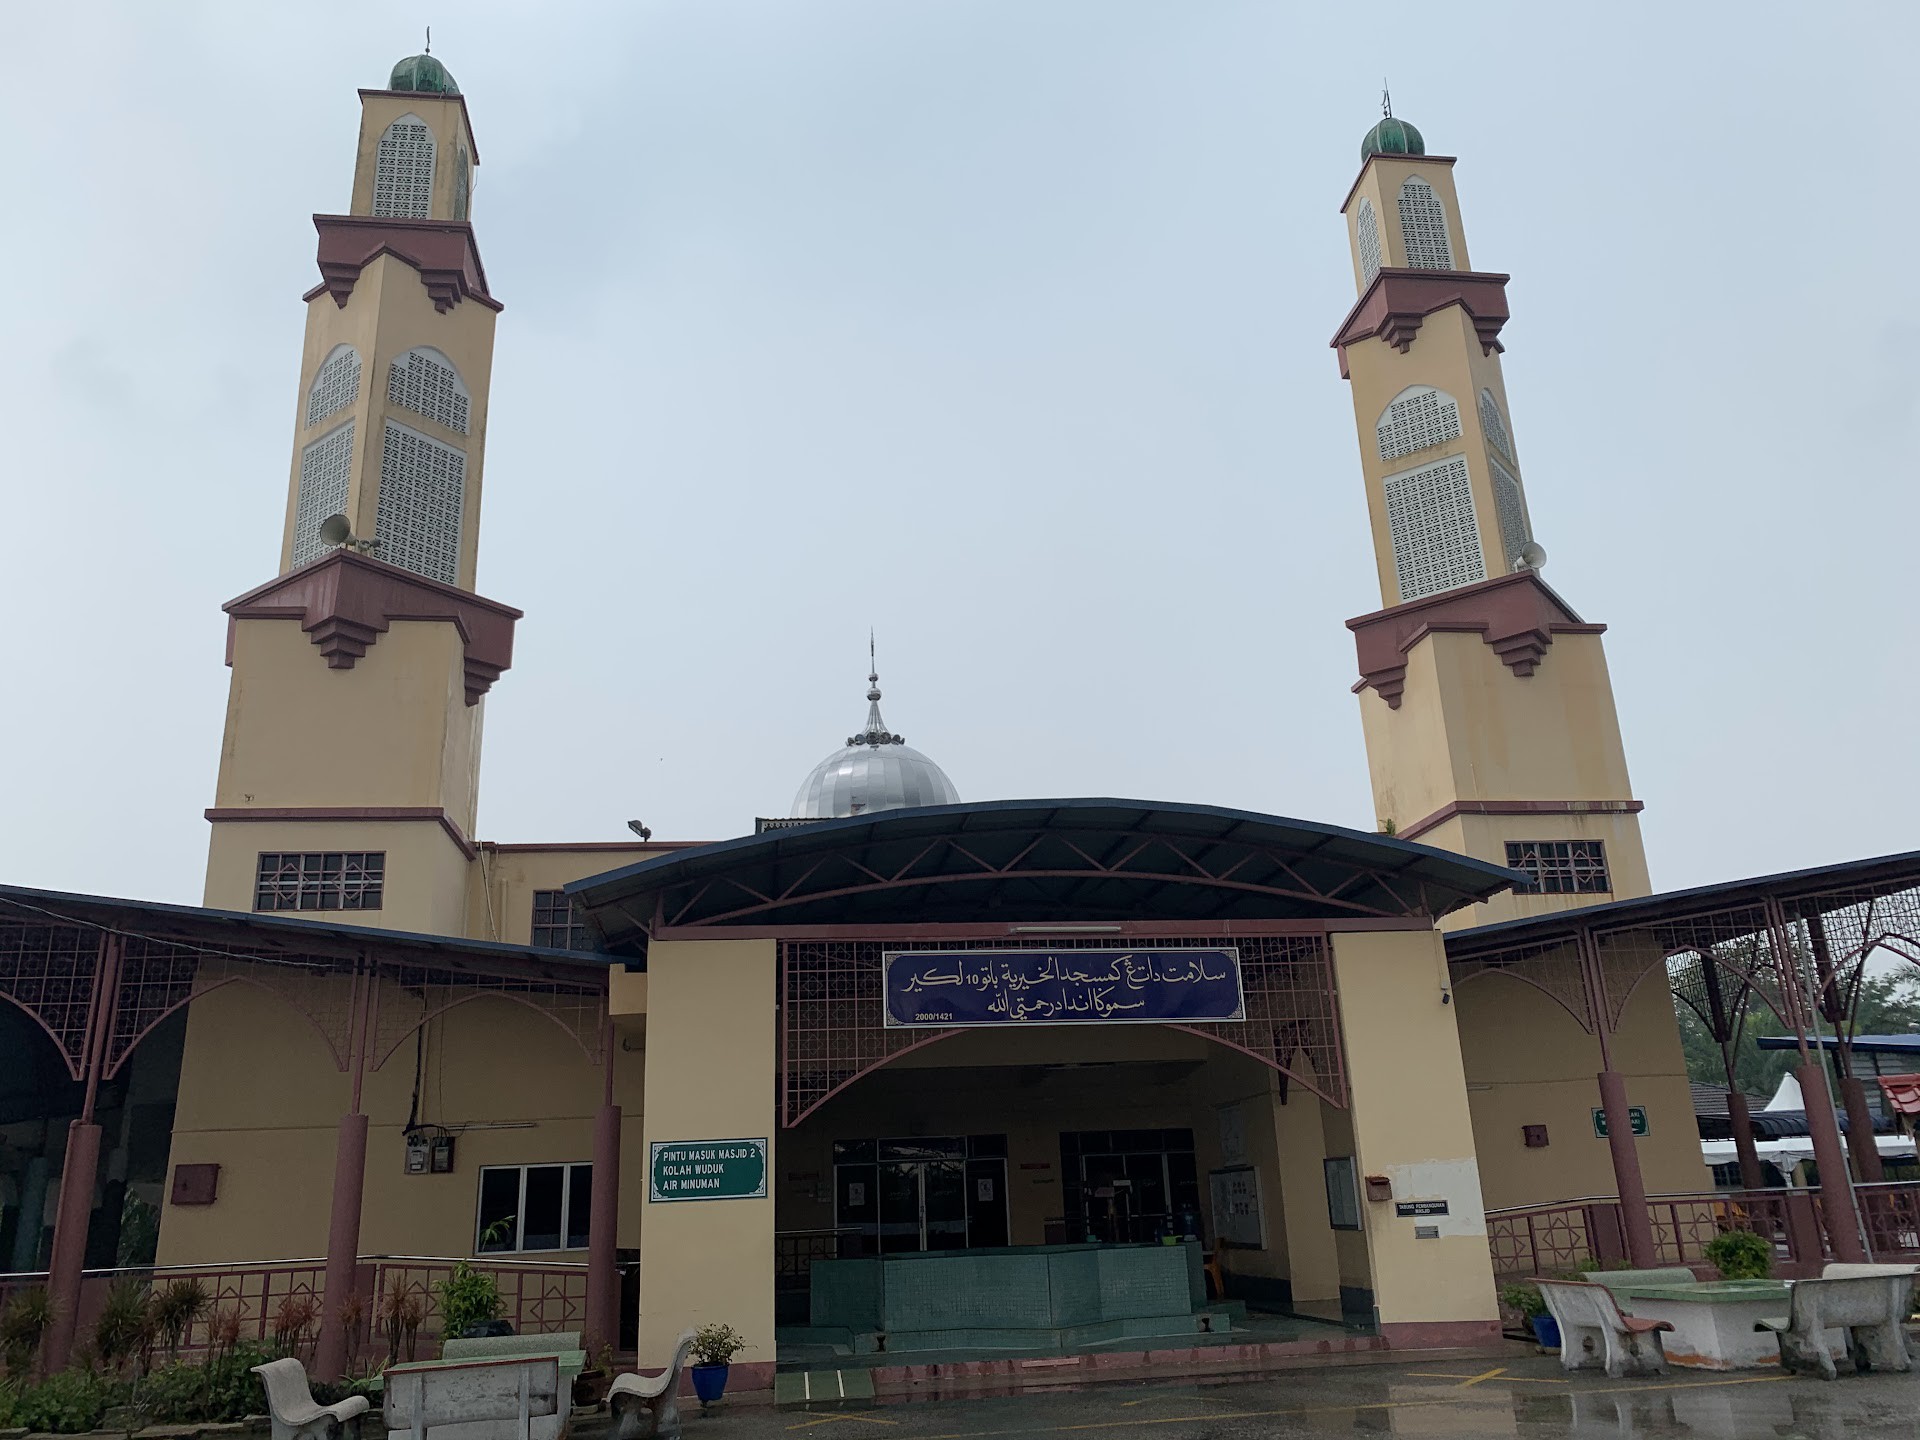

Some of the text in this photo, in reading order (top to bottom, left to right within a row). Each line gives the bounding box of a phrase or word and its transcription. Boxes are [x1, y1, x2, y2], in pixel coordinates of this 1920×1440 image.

[976, 960, 998, 991] باتو
[1162, 957, 1226, 984] سلامت
[966, 974, 979, 985] 10
[915, 1012, 953, 1021] 2000/1421
[663, 1147, 756, 1162] PINTU MASUK MASJID 2
[663, 1163, 724, 1176] KOLAH WUDUK
[662, 1178, 720, 1191] AIR MINUMAN
